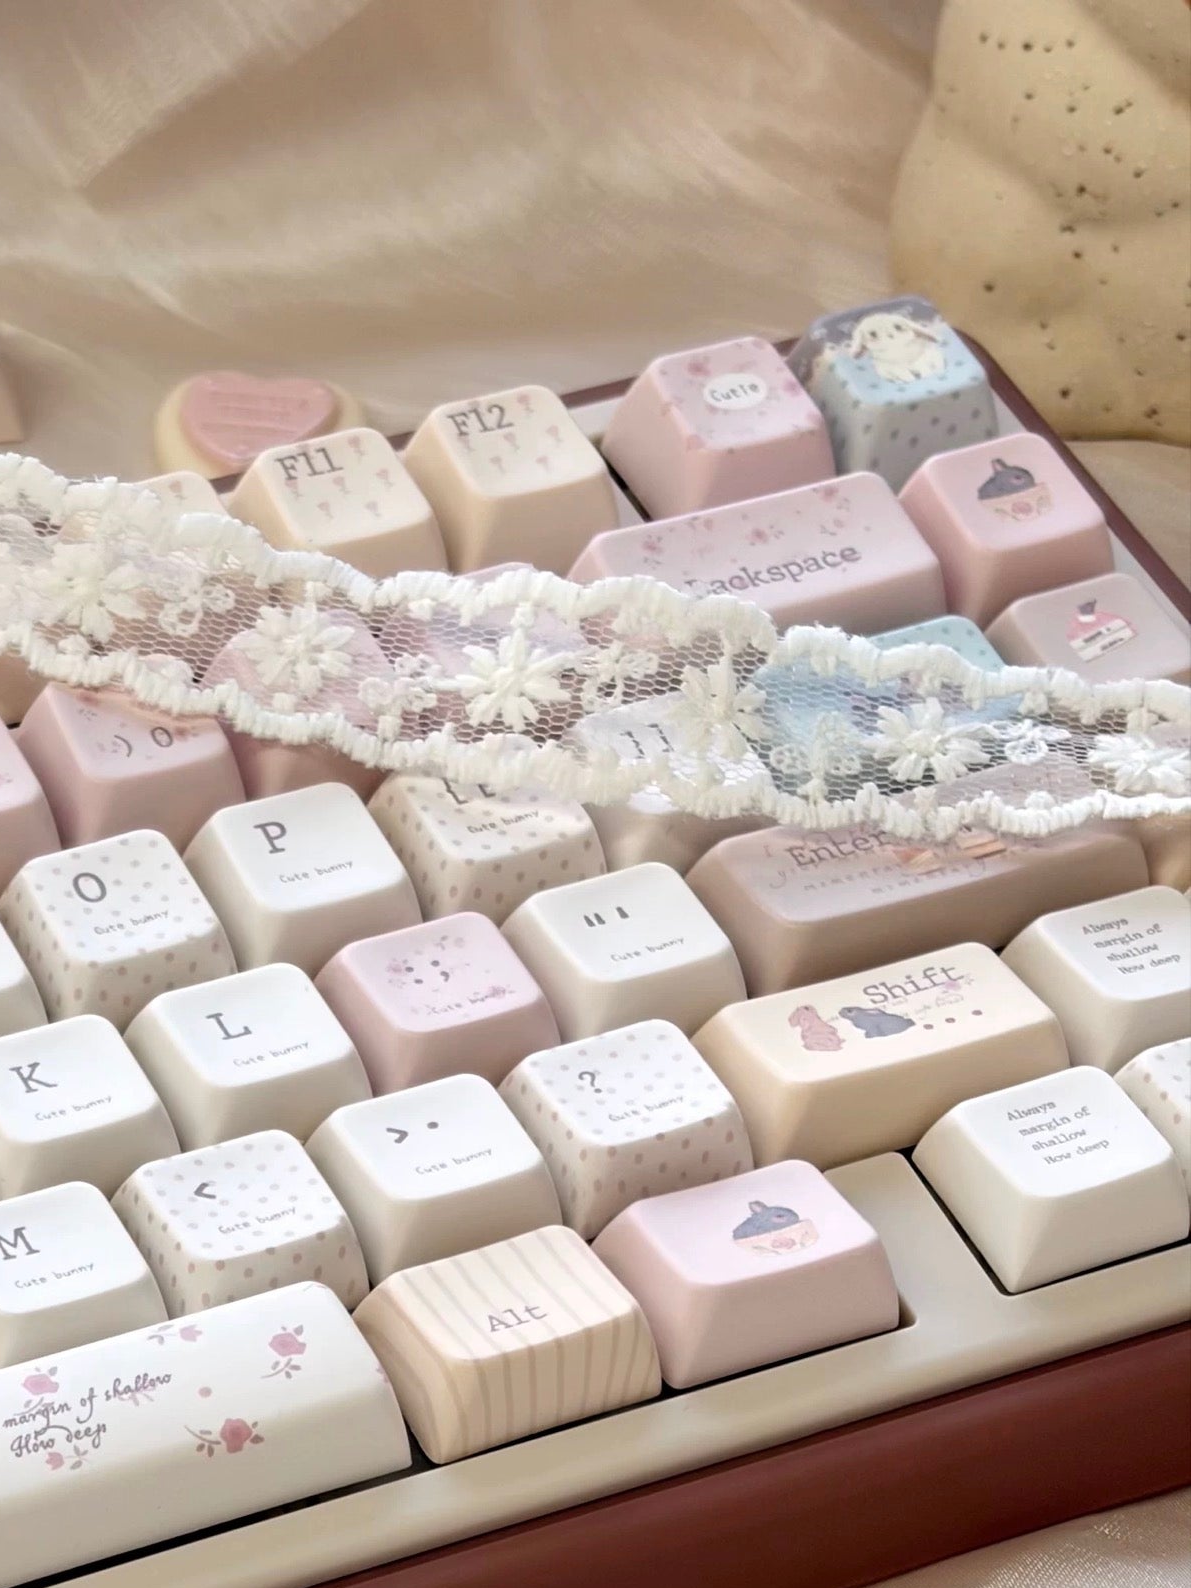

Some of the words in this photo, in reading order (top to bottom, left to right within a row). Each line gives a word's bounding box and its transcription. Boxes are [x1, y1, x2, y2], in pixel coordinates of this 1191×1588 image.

[447, 403, 513, 437] F12
[275, 447, 343, 481] F11
[254, 821, 287, 854] P
[786, 829, 890, 867] Enter
[279, 868, 311, 884] Cute
[315, 860, 353, 880] bunny
[1082, 918, 1128, 935] Always
[1146, 923, 1163, 935] of
[863, 967, 964, 1004] Shift
[206, 1011, 252, 1041] L
[233, 1051, 266, 1067] Cute
[271, 1041, 309, 1063] bunny
[9, 1061, 57, 1094] K
[578, 1071, 602, 1093] ?
[35, 1105, 69, 1122] Cute
[74, 1095, 112, 1116] bunny
[1006, 1101, 1056, 1121] Always
[1019, 1116, 1071, 1136] margin
[1074, 1106, 1091, 1119] of
[1032, 1128, 1086, 1151] shallow
[1076, 1139, 1109, 1155] deep
[415, 1158, 449, 1175] Cute
[453, 1148, 493, 1170] bunny
[14, 1272, 48, 1290] Cute
[54, 1262, 95, 1283] bunny
[486, 1306, 548, 1332] Alt
[3, 1402, 72, 1428] margin
[76, 1387, 97, 1424] of
[105, 1371, 172, 1402] shallow
[11, 1428, 55, 1457] How
